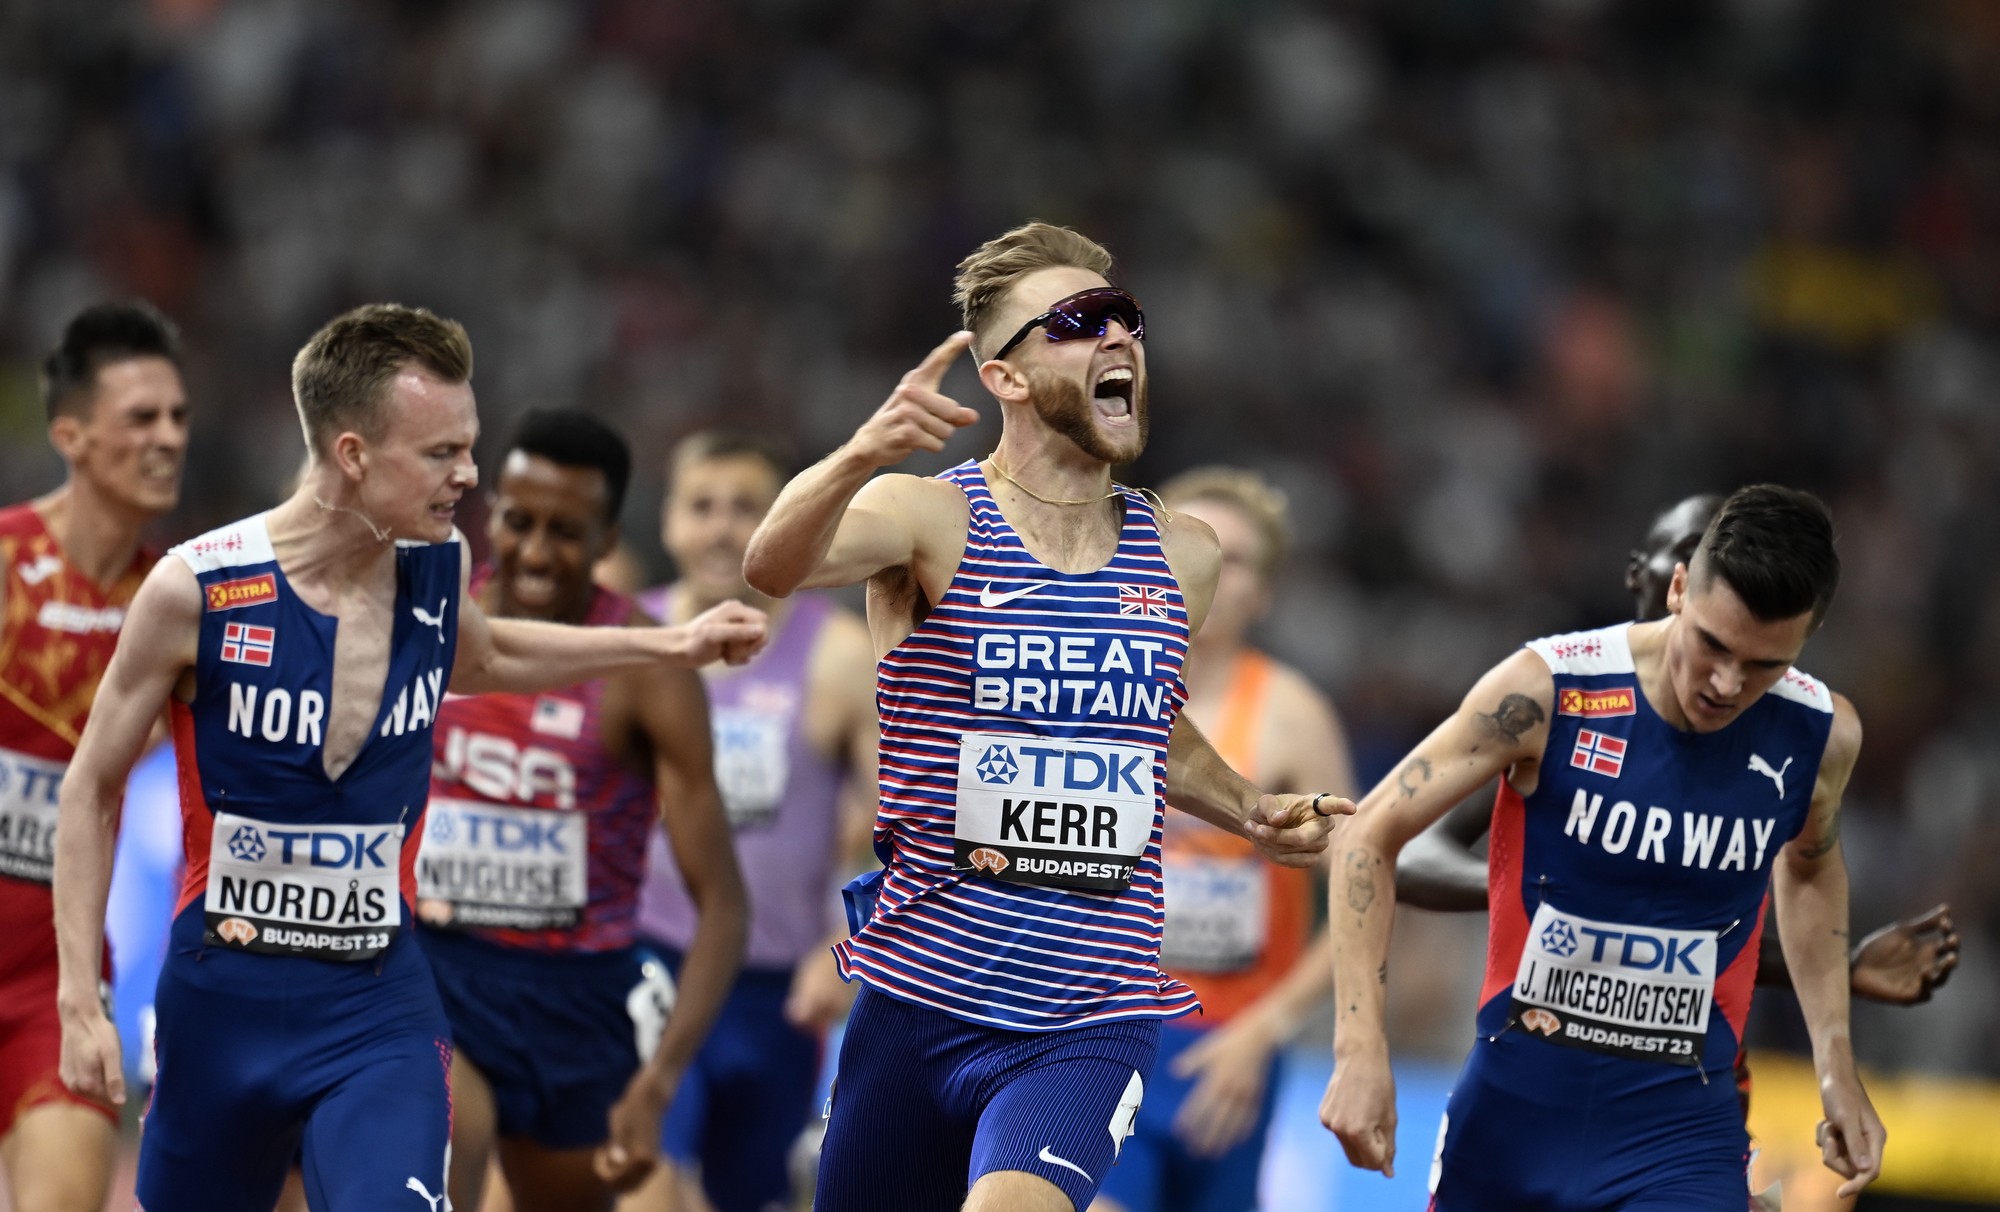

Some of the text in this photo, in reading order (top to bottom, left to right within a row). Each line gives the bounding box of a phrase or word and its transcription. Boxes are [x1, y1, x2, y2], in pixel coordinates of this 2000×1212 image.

[228, 581, 272, 600] EXTRA
[976, 633, 1163, 676] GREAT
[974, 676, 1164, 721] BRITAIN
[1583, 692, 1631, 711] EXTRA
[1020, 746, 1146, 796] TDK
[460, 812, 567, 856] TDK
[1000, 798, 1118, 849] KERR
[1564, 788, 1776, 872] NORWAY
[267, 830, 390, 870] TDK
[1016, 856, 1122, 880] BUDAPEST
[219, 875, 387, 925] NORDÅS
[262, 926, 390, 951] BUDAPEST 23
[1580, 926, 1705, 976] TDK
[1520, 960, 1705, 1027] J. INGEBRIGTSEN
[1565, 1022, 1694, 1056] BUDAPEST 23
